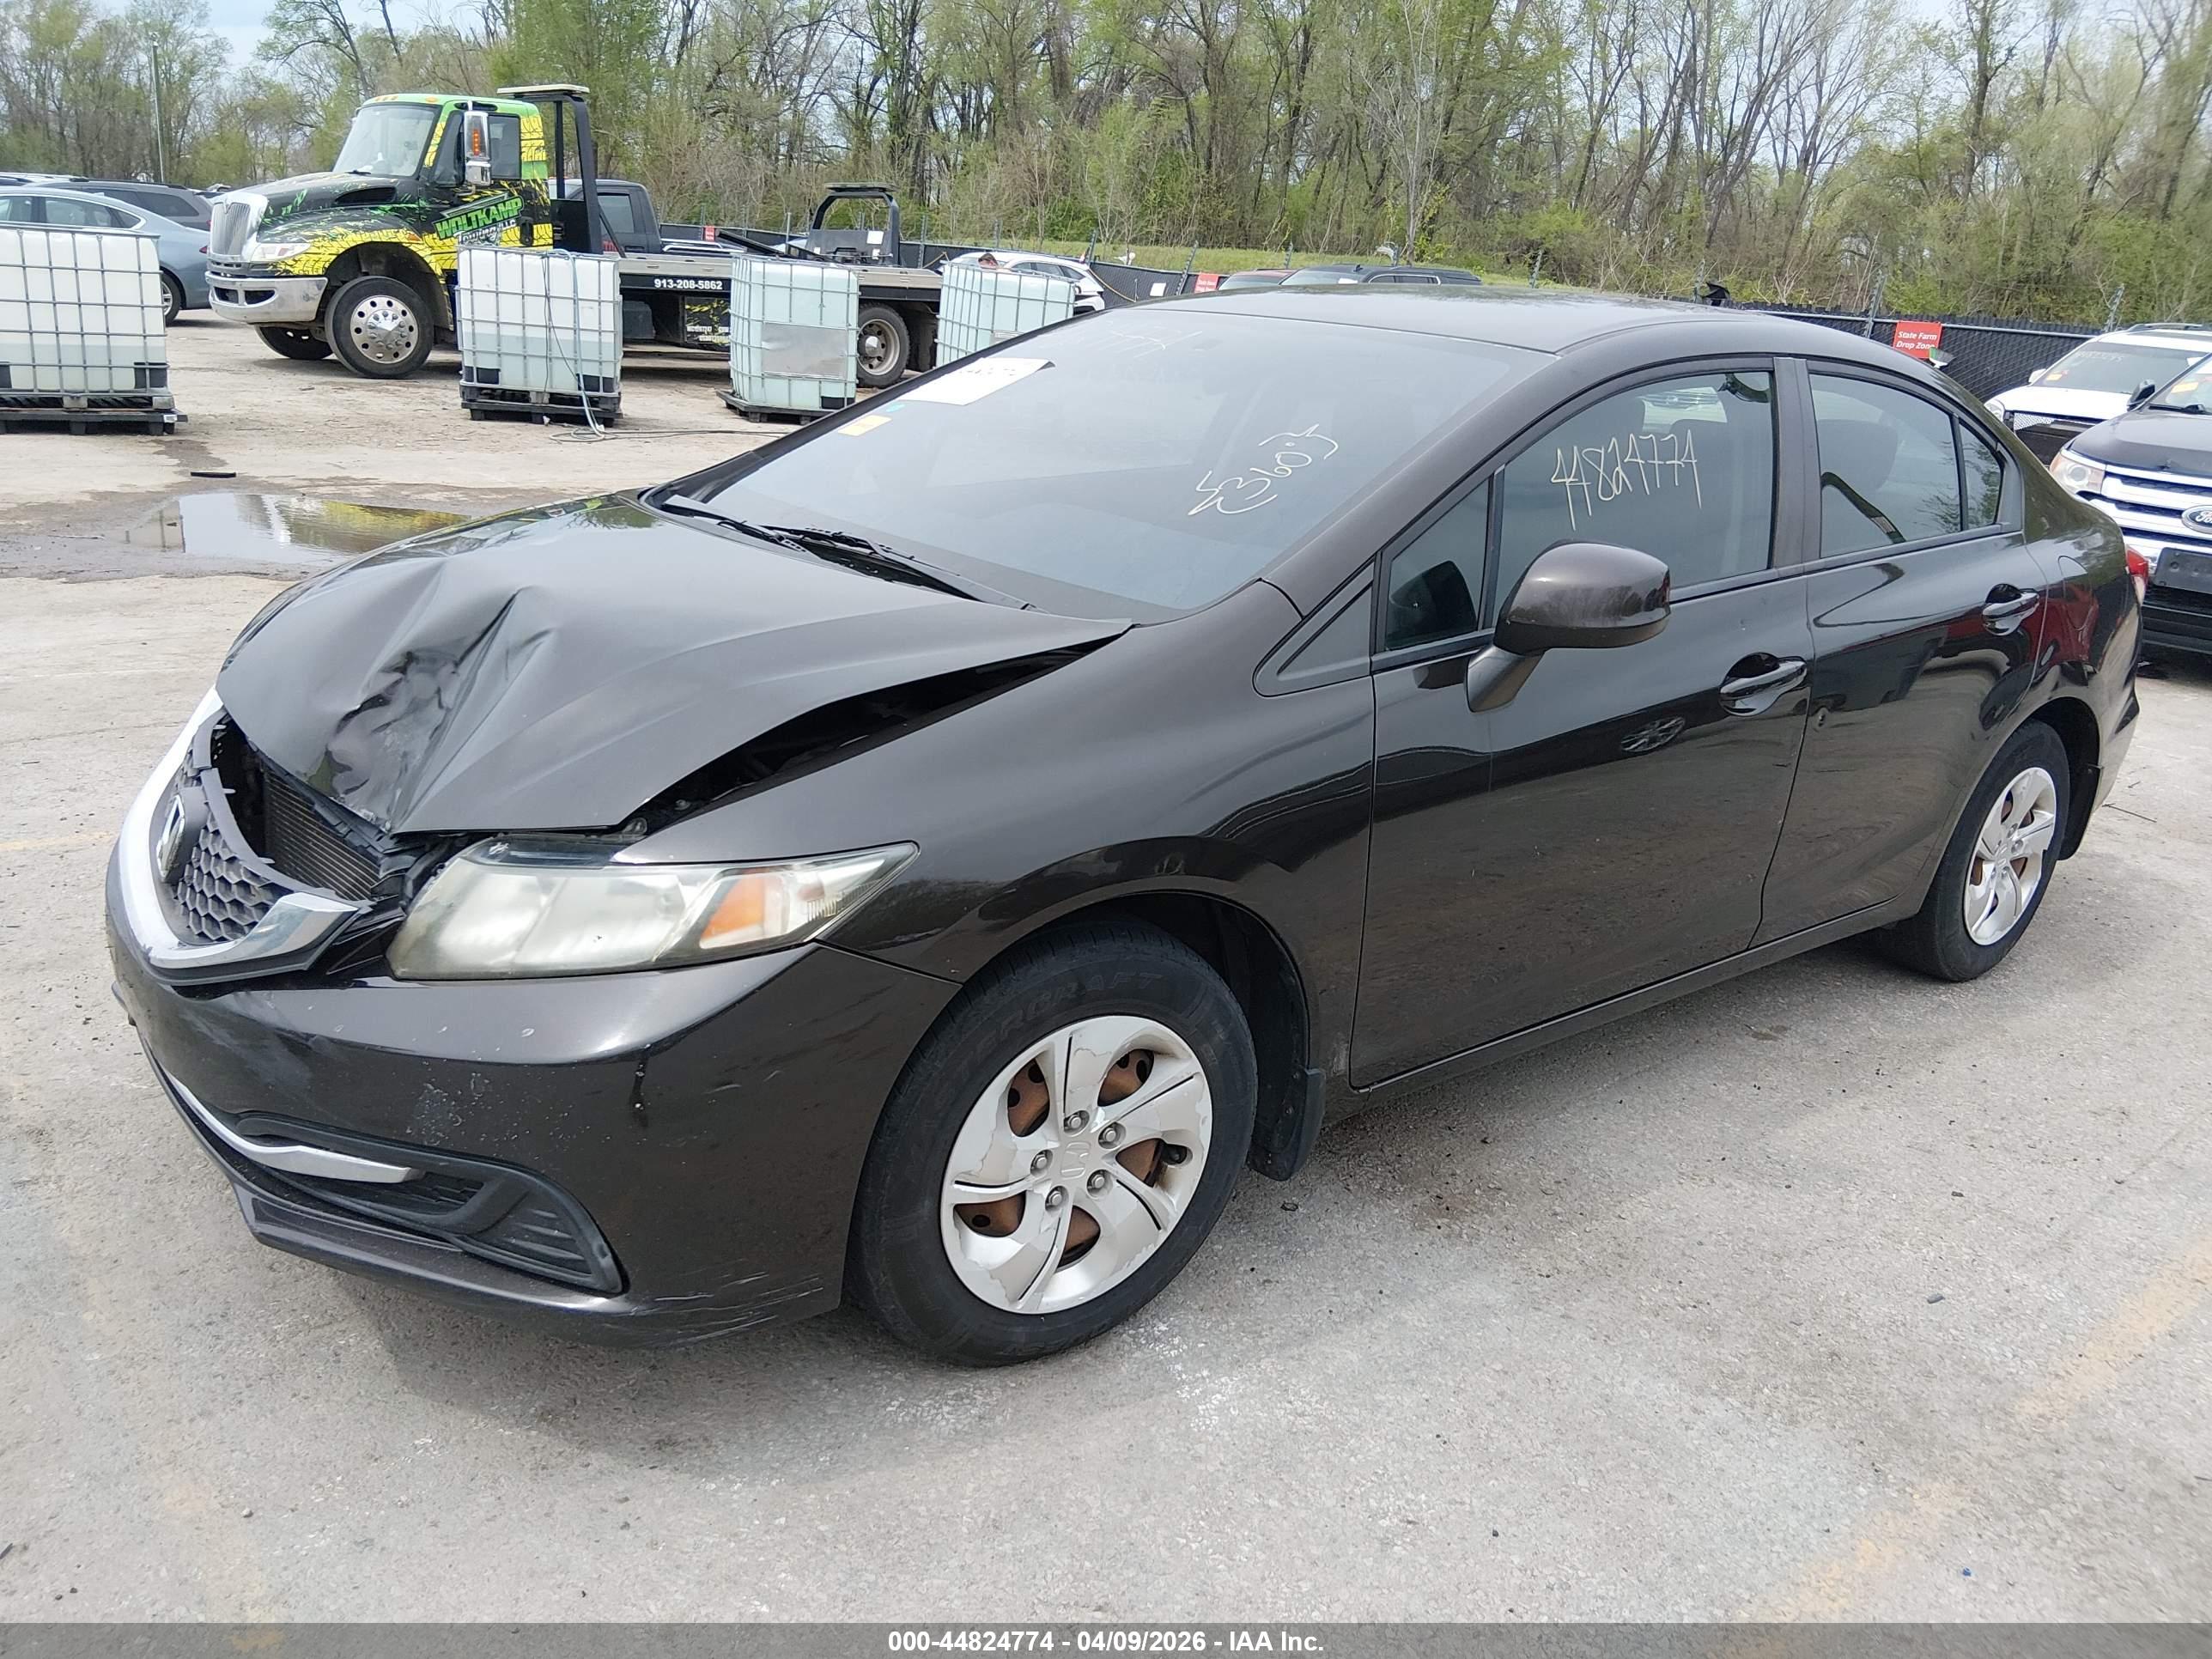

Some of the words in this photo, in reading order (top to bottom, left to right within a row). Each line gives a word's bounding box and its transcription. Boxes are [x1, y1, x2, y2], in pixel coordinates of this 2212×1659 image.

[434, 198, 523, 240] WOLTKAMP
[453, 226, 496, 242] Towing
[653, 278, 723, 290] 913-208-5862
[1896, 341, 1915, 350] Drop
[1551, 428, 1703, 531] 44824774
